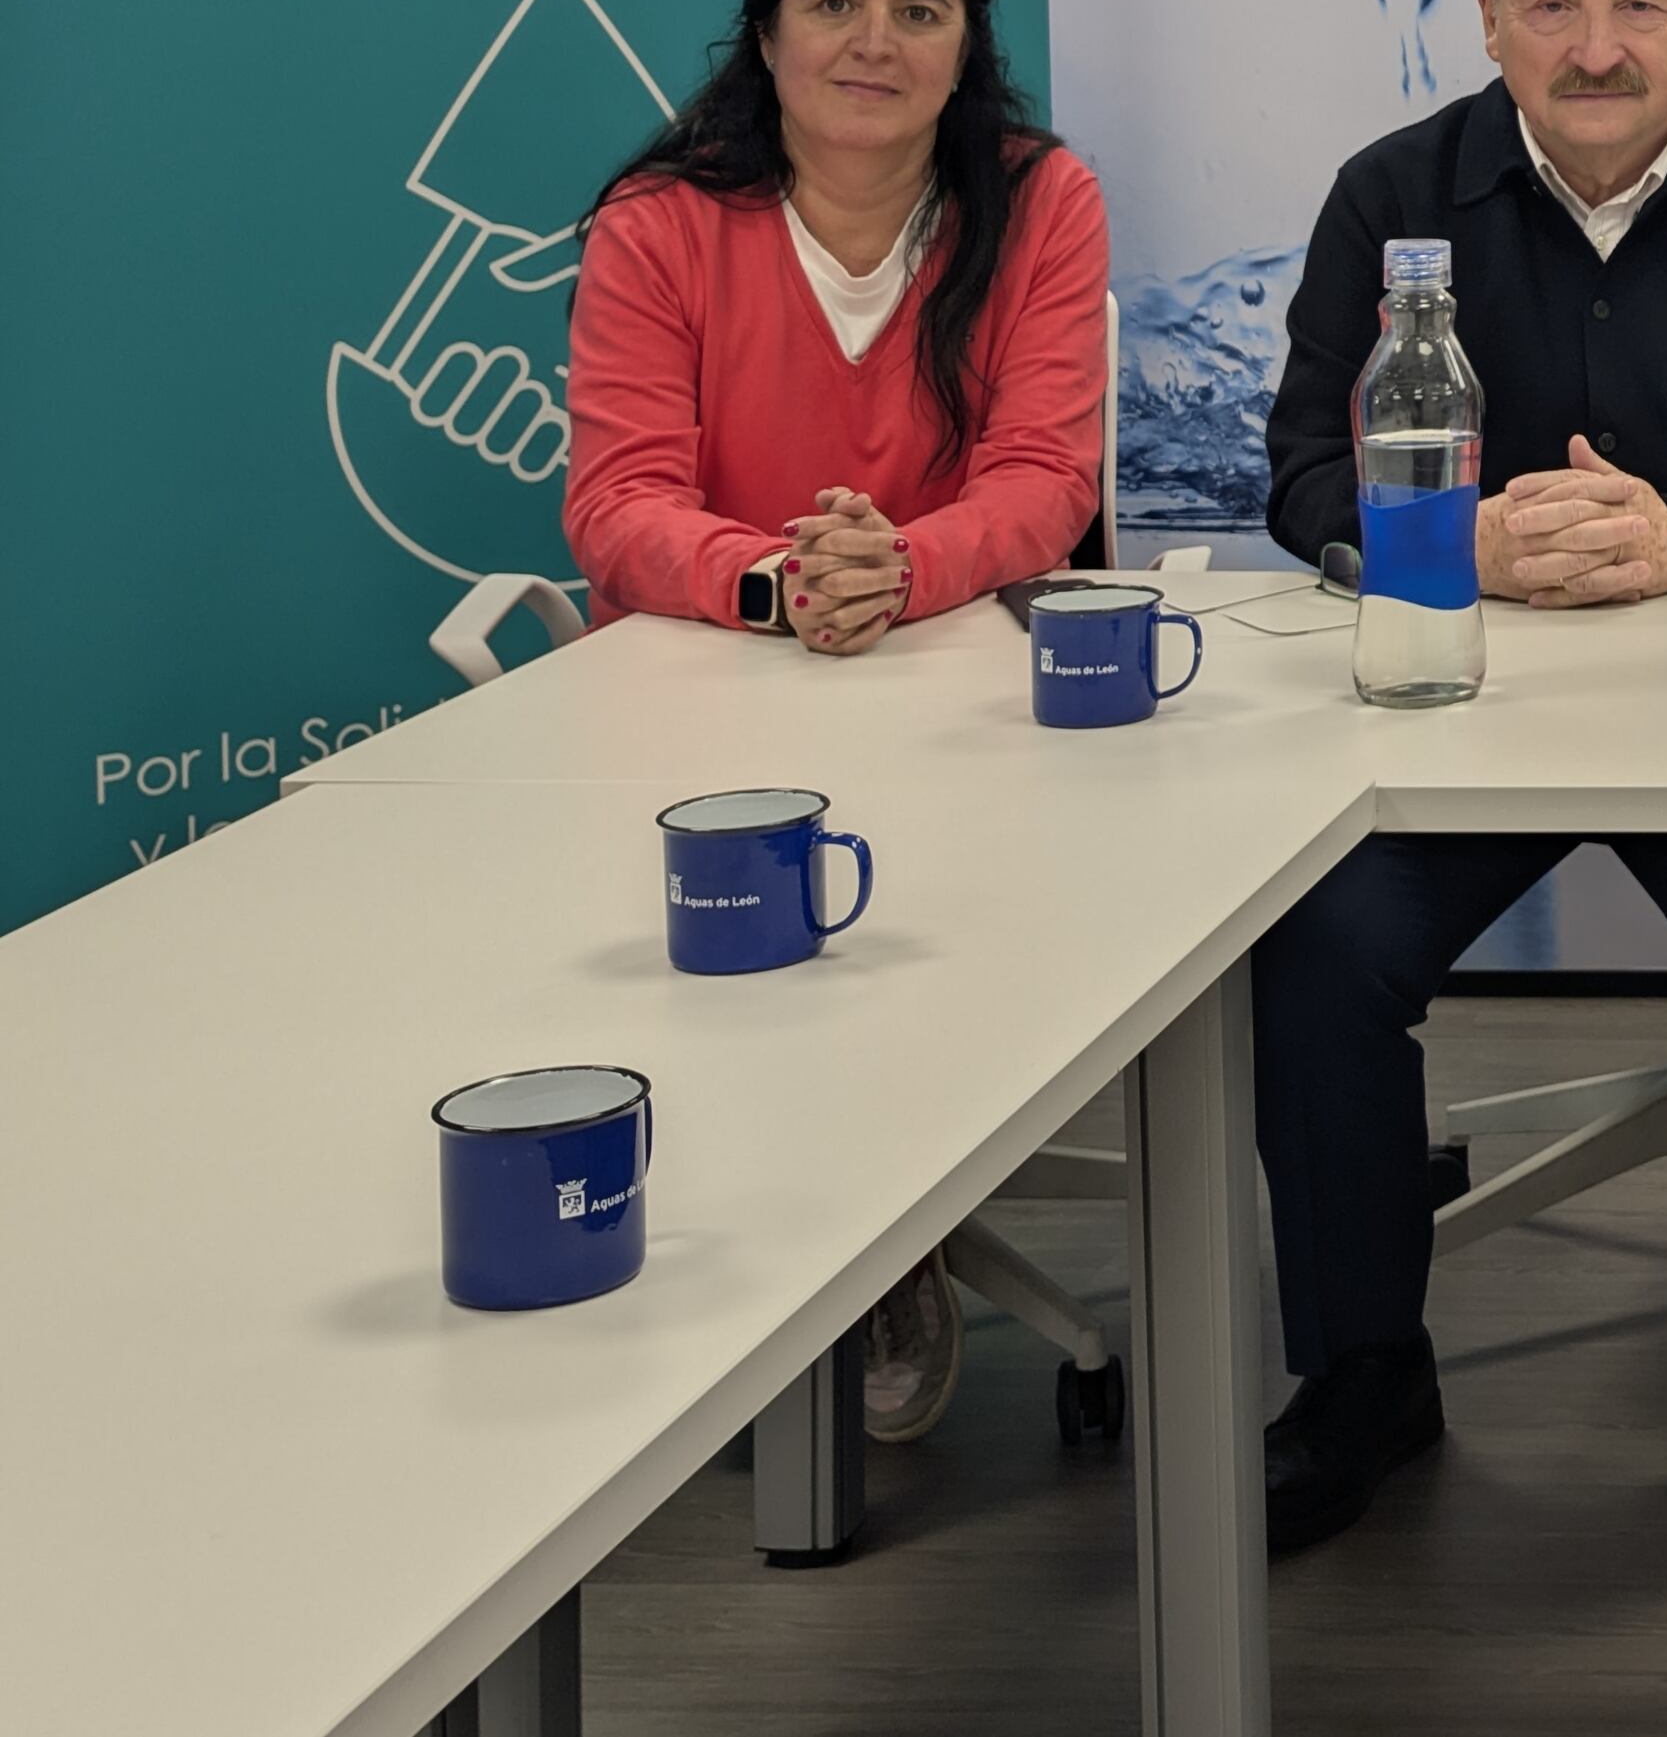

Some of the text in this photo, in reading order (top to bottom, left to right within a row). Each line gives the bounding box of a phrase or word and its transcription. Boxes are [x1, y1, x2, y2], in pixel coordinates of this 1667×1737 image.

[1055, 664, 1119, 676] Aguas de León
[96, 750, 202, 805] Por
[221, 732, 277, 782] la
[684, 895, 760, 909] Aguas de León
[591, 1191, 626, 1213] Aguas
